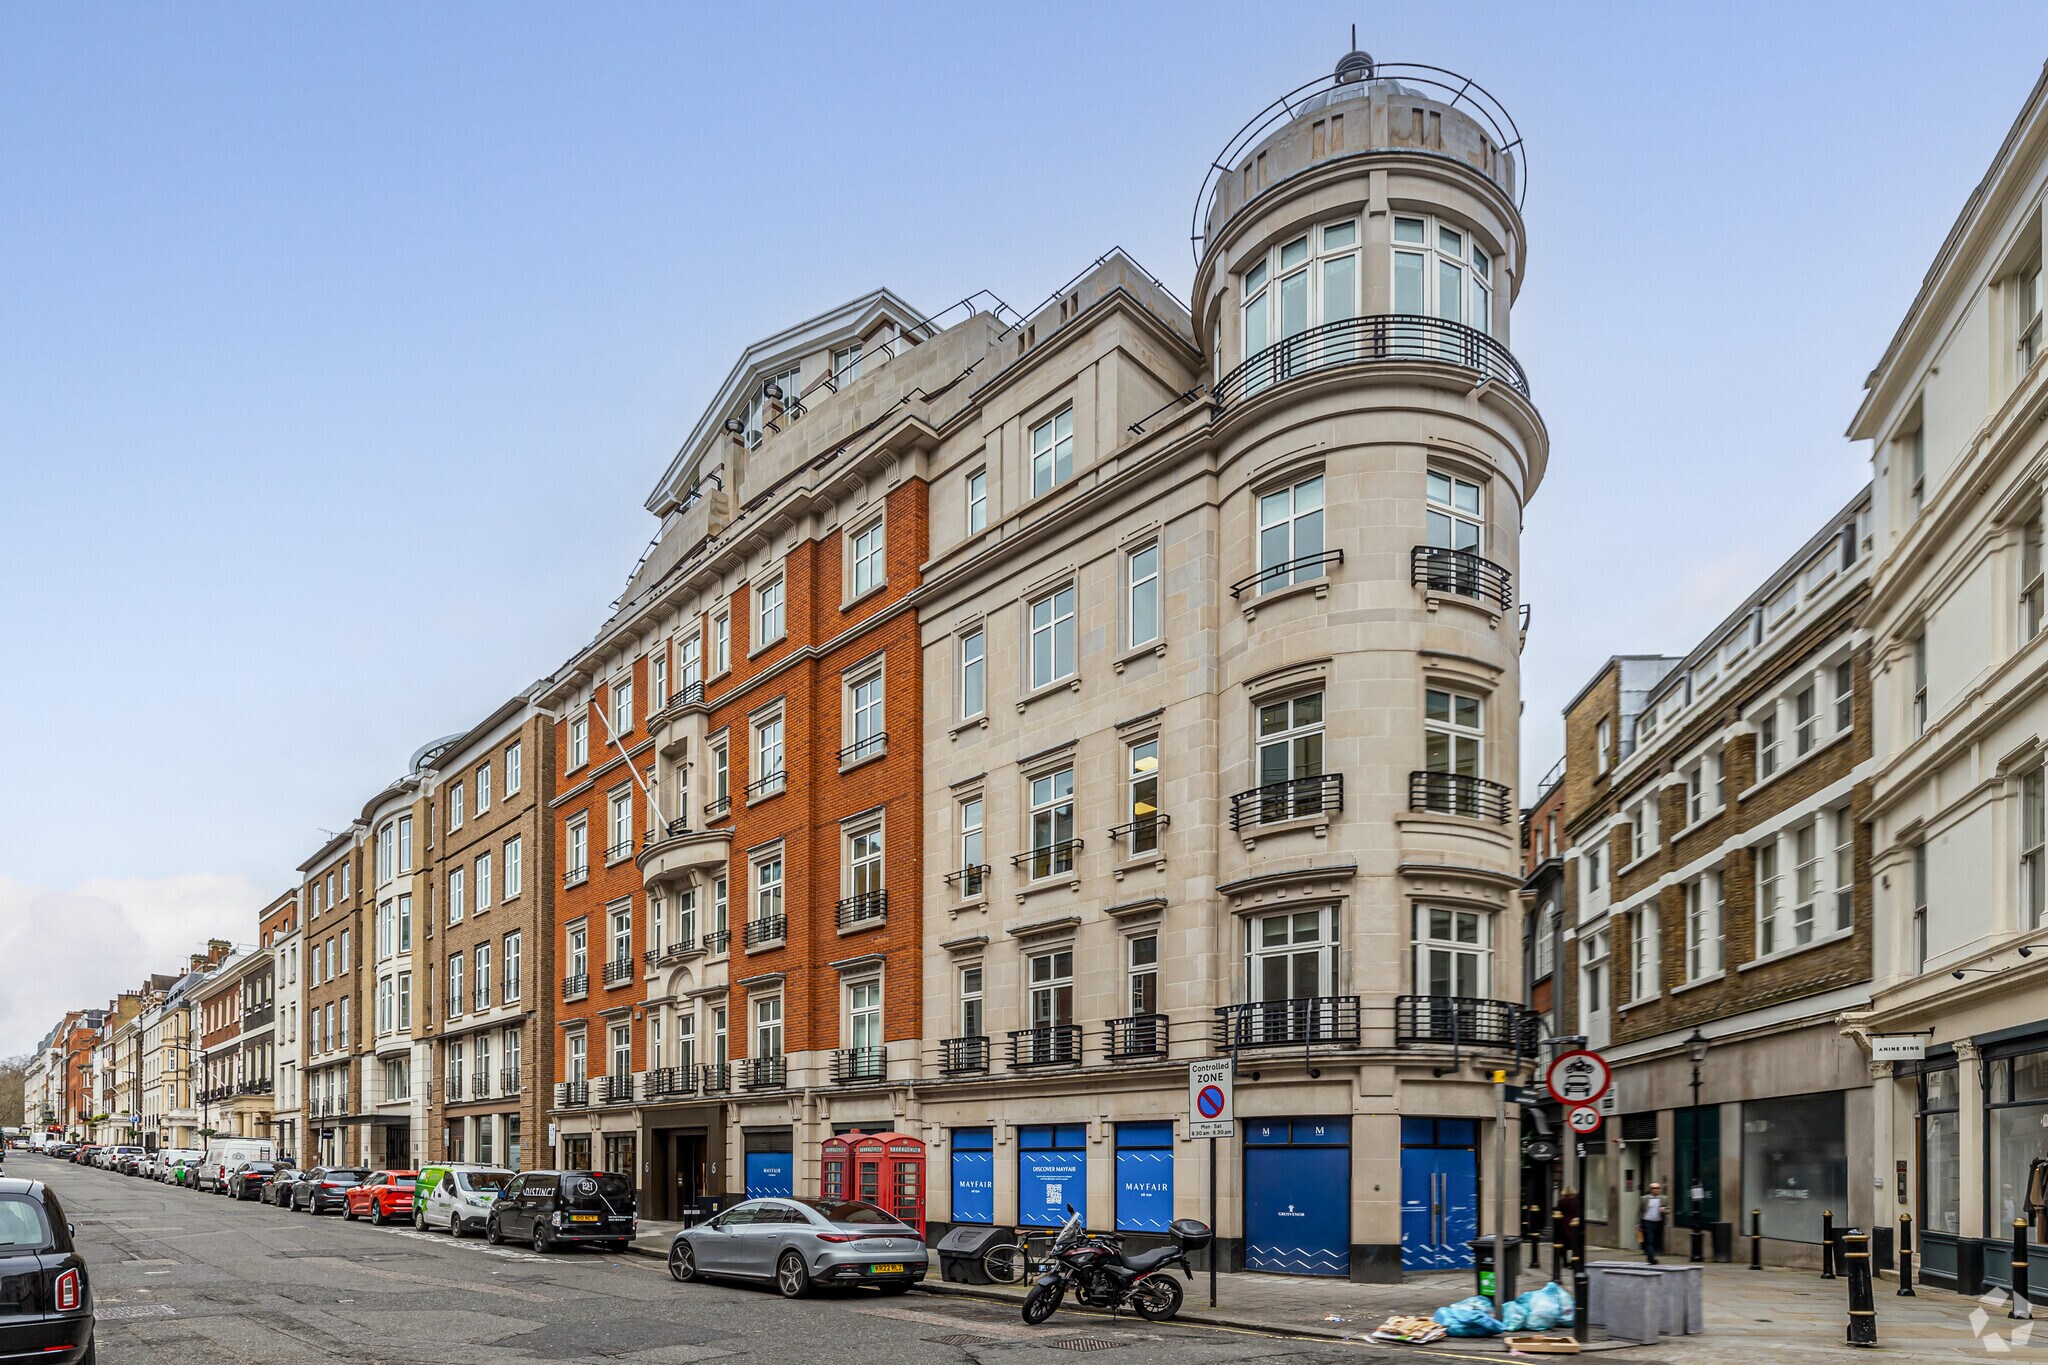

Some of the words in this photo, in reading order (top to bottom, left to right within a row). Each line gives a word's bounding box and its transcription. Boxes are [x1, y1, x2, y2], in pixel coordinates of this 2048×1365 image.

[1192, 1061, 1229, 1073] Controlled
[1197, 1072, 1224, 1083] ZONE
[1573, 1113, 1597, 1125] 20
[1262, 1127, 1270, 1135] M
[1315, 1126, 1325, 1134] M
[711, 1162, 717, 1174] 6
[959, 1180, 992, 1188] MAYFAIR
[1125, 1183, 1168, 1191] MAYFAIR
